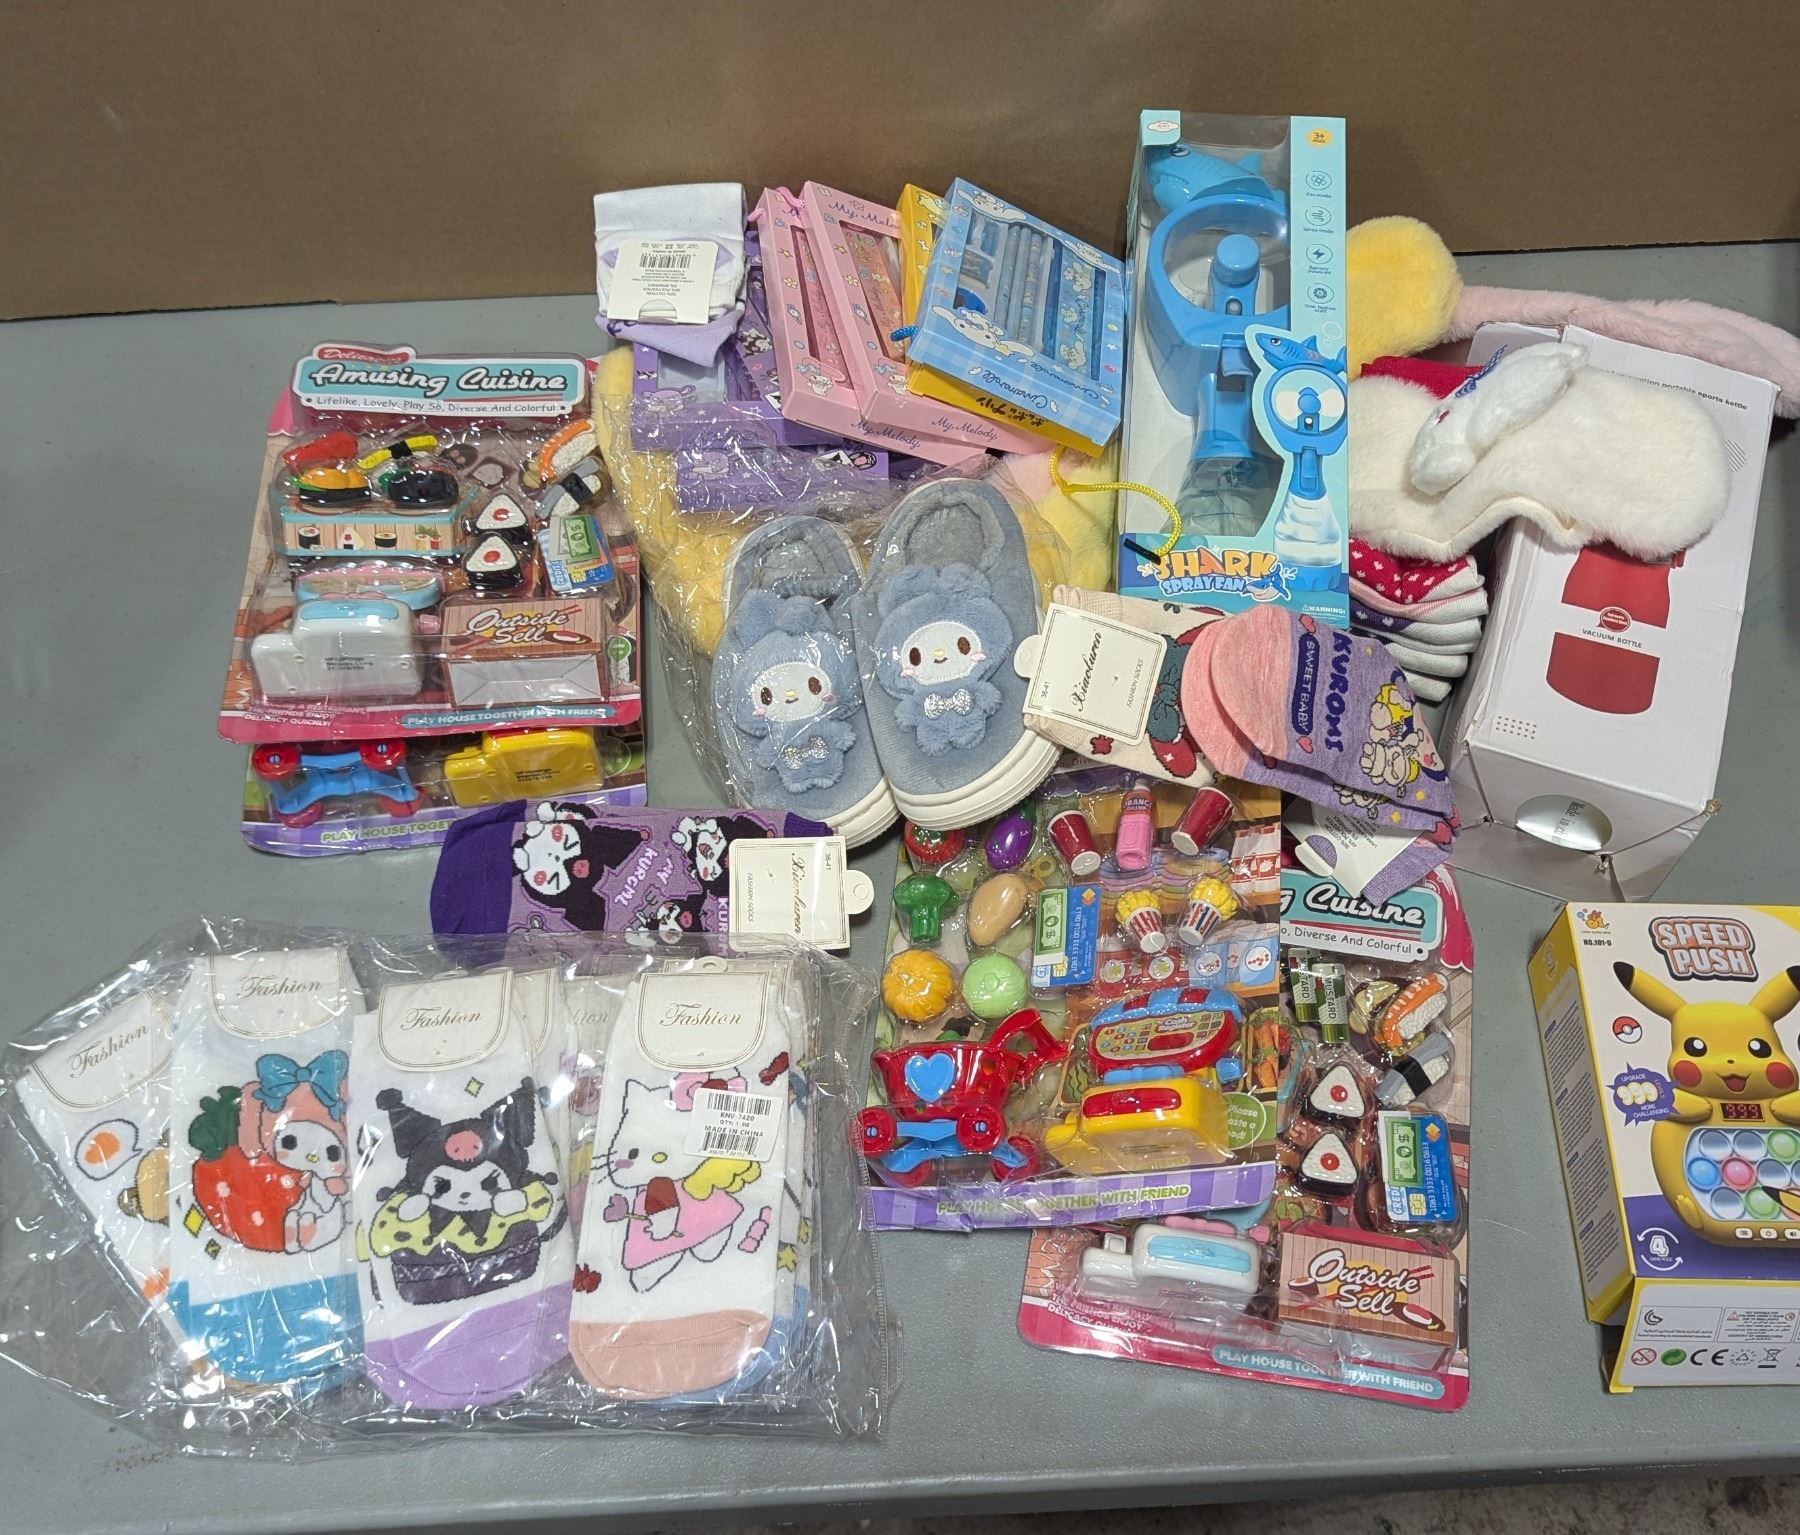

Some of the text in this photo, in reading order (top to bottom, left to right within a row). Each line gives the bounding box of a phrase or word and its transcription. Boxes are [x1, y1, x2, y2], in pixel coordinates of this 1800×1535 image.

[312, 363, 566, 397] Amusing Cuisine
[316, 397, 358, 408] Lifelike,
[364, 398, 400, 410] Lovely,
[403, 400, 427, 412] Play
[448, 403, 487, 412] Diverse
[492, 404, 511, 412] And
[515, 404, 556, 412] Colorful
[1698, 391, 1723, 403] sports
[1725, 399, 1747, 410] kettle
[1153, 548, 1279, 580] SHARK
[1161, 576, 1246, 594] SPRAY FAN
[467, 608, 569, 633] Outside
[1309, 606, 1345, 614] WARNING!
[492, 627, 546, 645] Sell
[1582, 628, 1642, 648] VACUUM BOTTLE
[1126, 656, 1144, 709] FASHION SOCKS
[1298, 641, 1315, 734] SWEET BABY
[1325, 632, 1352, 752] KUROMI
[438, 714, 477, 724] HOUSE
[322, 829, 357, 843] PLAY
[361, 825, 406, 838] HOUSE
[1281, 927, 1411, 954] o, Diverse And Colorful
[1655, 922, 1746, 947] SPEED
[1674, 949, 1751, 975] PUSH
[238, 975, 323, 1001] Fashion
[1324, 978, 1337, 1020] MUSTARD
[401, 1007, 481, 1031] Fashion
[660, 1002, 742, 1026] Fashion
[1164, 1017, 1188, 1026] Cash
[1158, 1023, 1195, 1032] Register
[70, 1023, 149, 1079] Fashion
[1621, 1073, 1647, 1082] UPGRADE
[720, 1112, 754, 1121] KNV-7420
[1228, 1119, 1248, 1127] aste
[1633, 1107, 1670, 1118] CHALLENGING
[1725, 1104, 1759, 1119] 999
[705, 1125, 726, 1133] MADE
[1101, 1187, 1140, 1208] WITH
[1141, 1184, 1191, 1202] FRIEND
[1389, 1186, 1403, 1215] CREDI
[1650, 1235, 1669, 1257] 4
[1308, 1248, 1420, 1293] Outside
[1337, 1284, 1394, 1315] Sell
[1220, 1351, 1434, 1393] PLAY HOUSE WITH FRIEND
